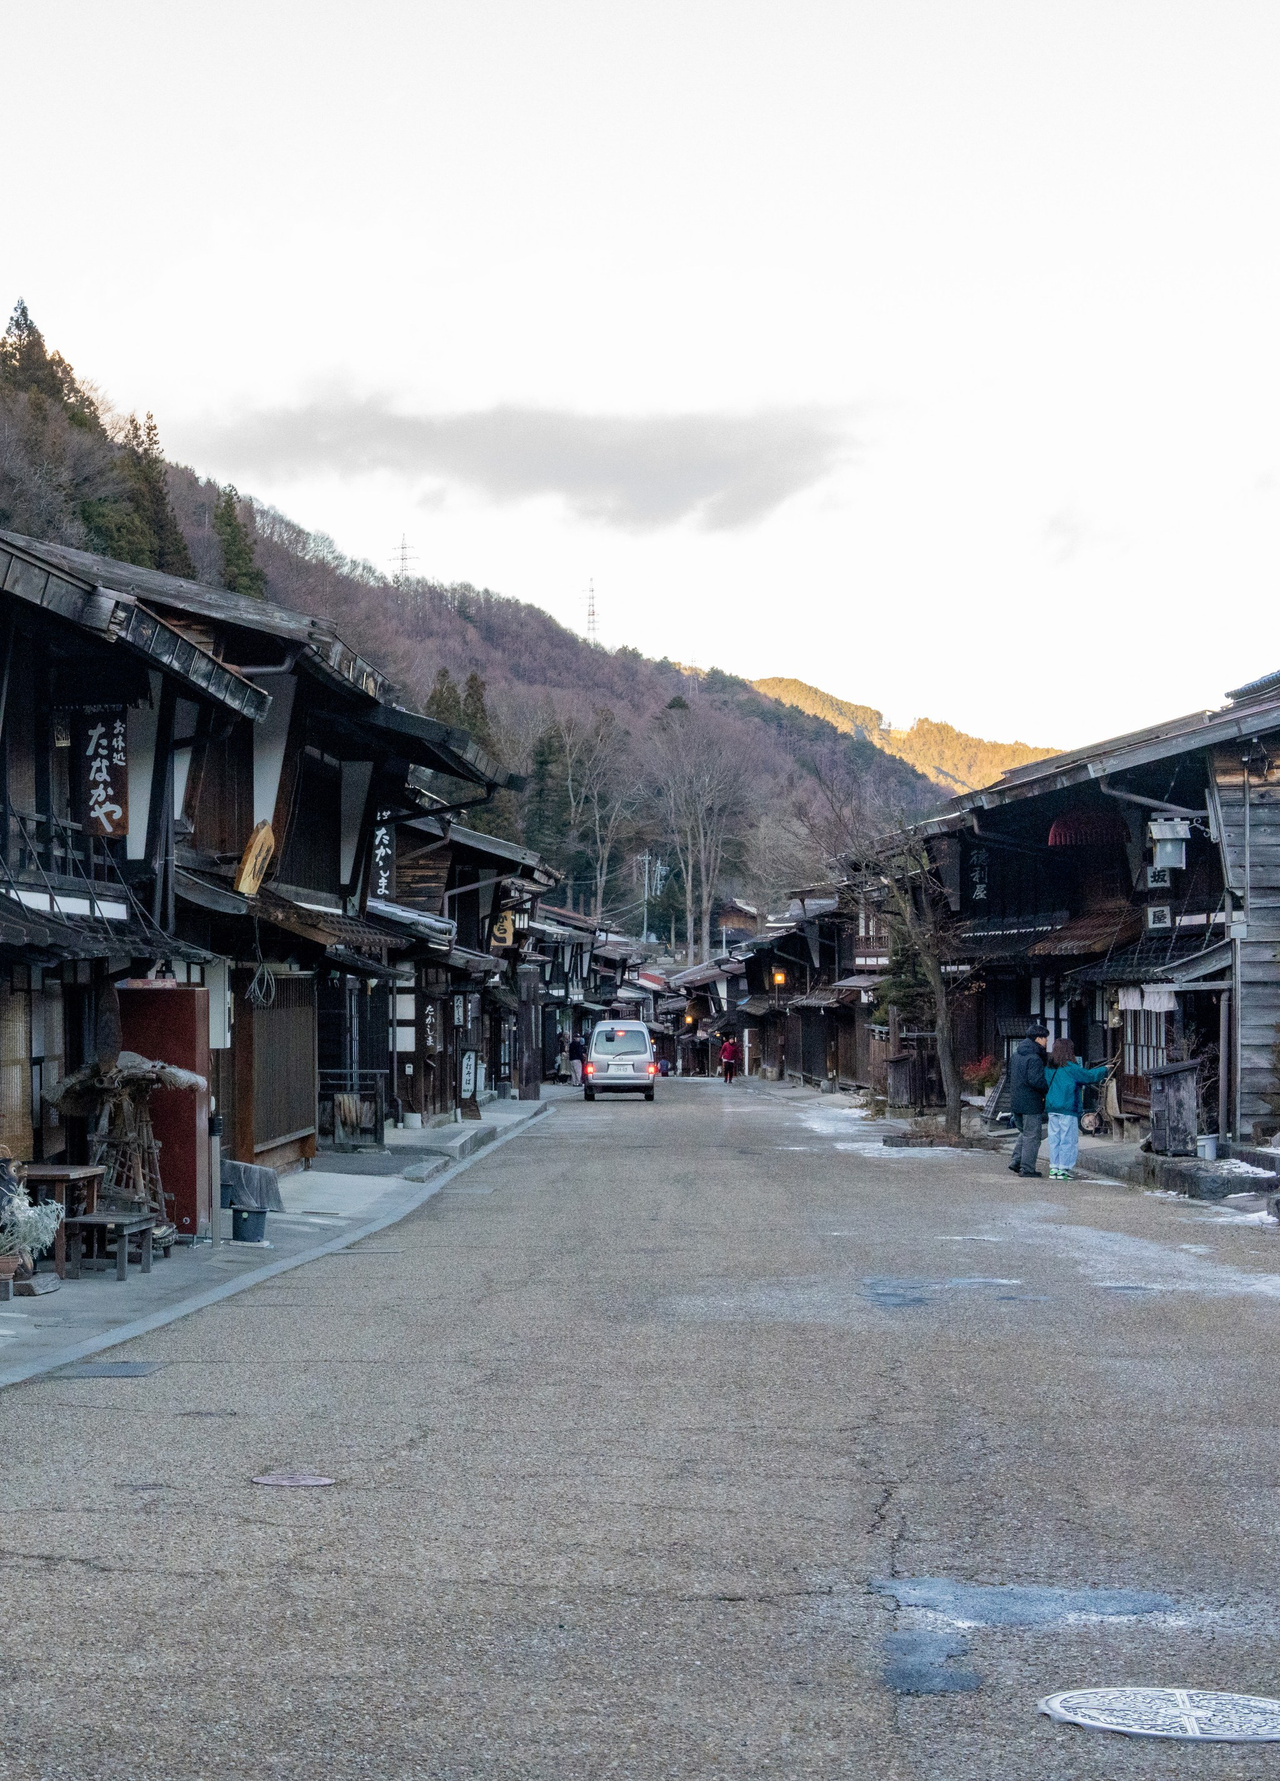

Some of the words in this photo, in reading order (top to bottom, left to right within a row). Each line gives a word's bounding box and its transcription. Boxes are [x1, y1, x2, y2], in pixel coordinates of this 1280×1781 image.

[111, 719, 126, 766] お休処
[85, 722, 123, 832] たなかや
[375, 827, 392, 895] たかしま
[424, 1004, 436, 1046] たかしま
